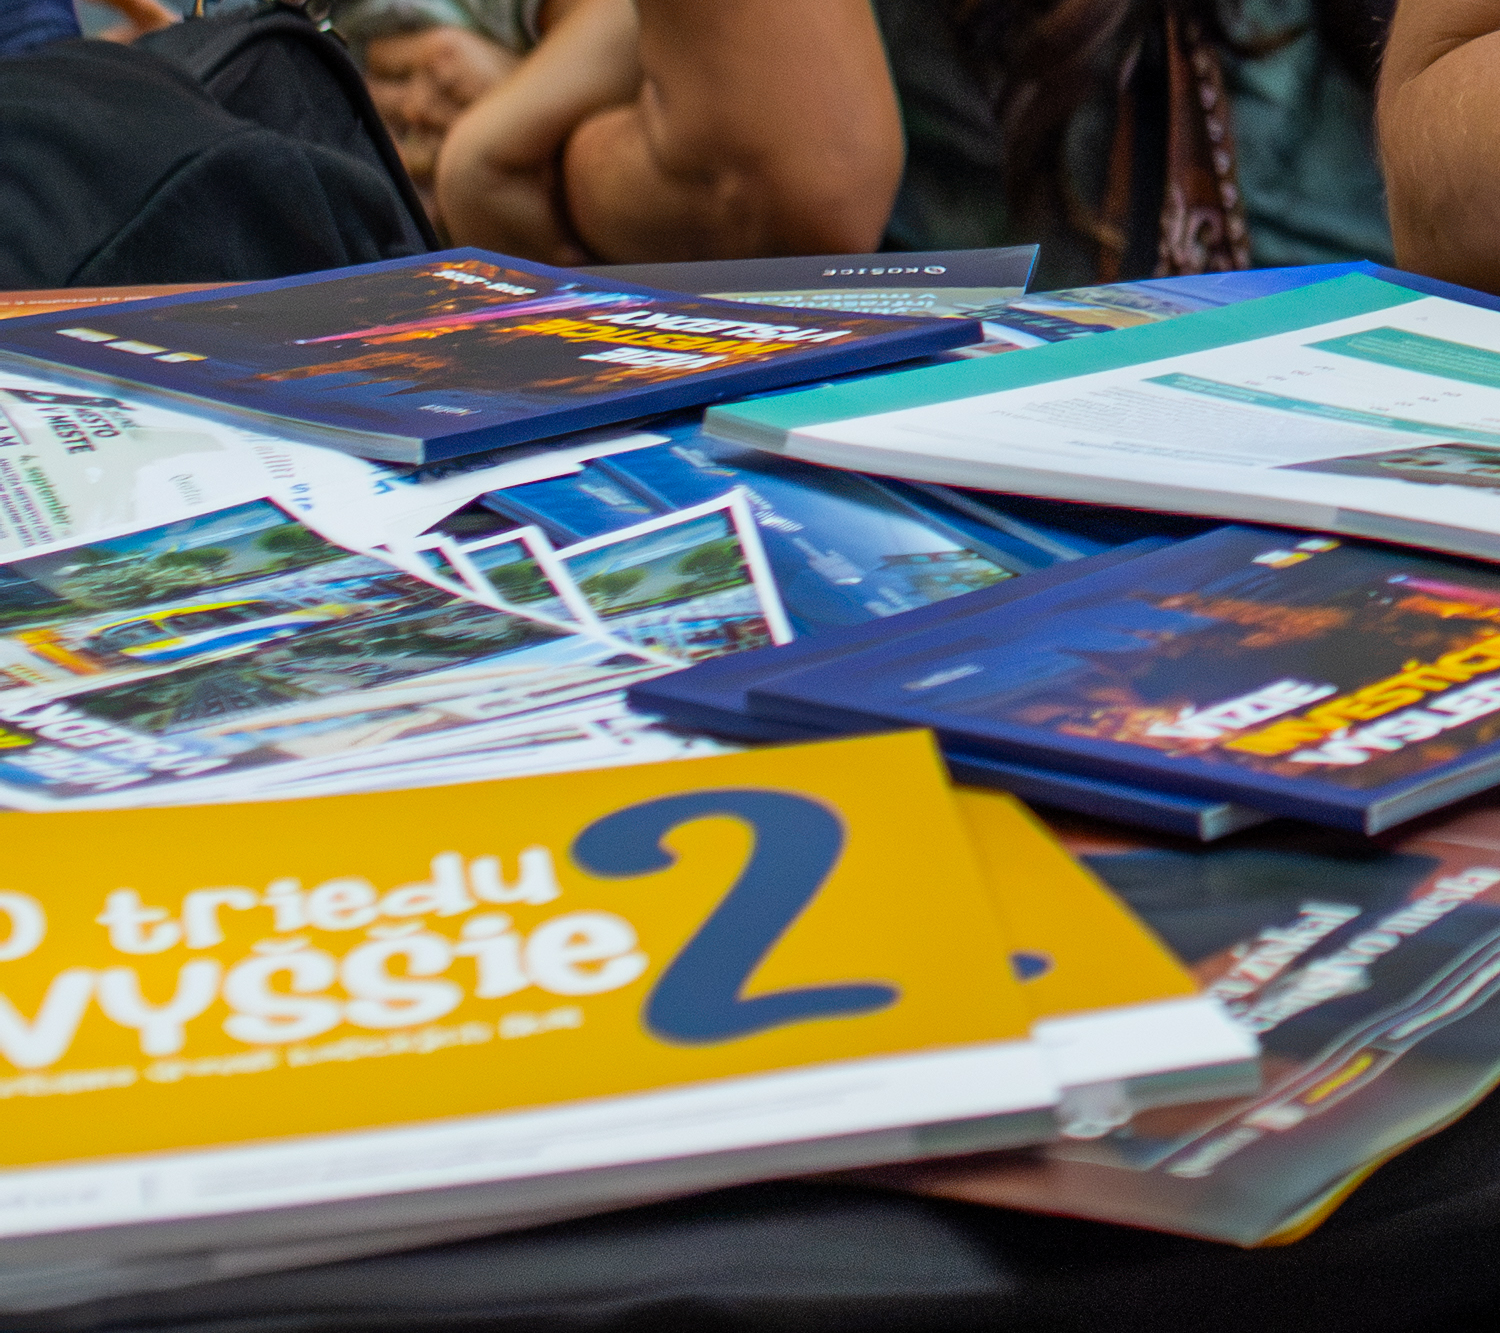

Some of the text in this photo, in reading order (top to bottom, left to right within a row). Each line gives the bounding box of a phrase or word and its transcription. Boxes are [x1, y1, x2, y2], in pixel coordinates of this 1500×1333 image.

[514, 318, 797, 354] INVESTÍCIE
[588, 310, 852, 343] VÝSLEDKY
[578, 347, 725, 370] VÍZIE
[42, 414, 98, 454] MESTE
[1146, 678, 1338, 740] VÍZIE
[95, 844, 561, 954] triedu
[569, 787, 902, 1047] 2
